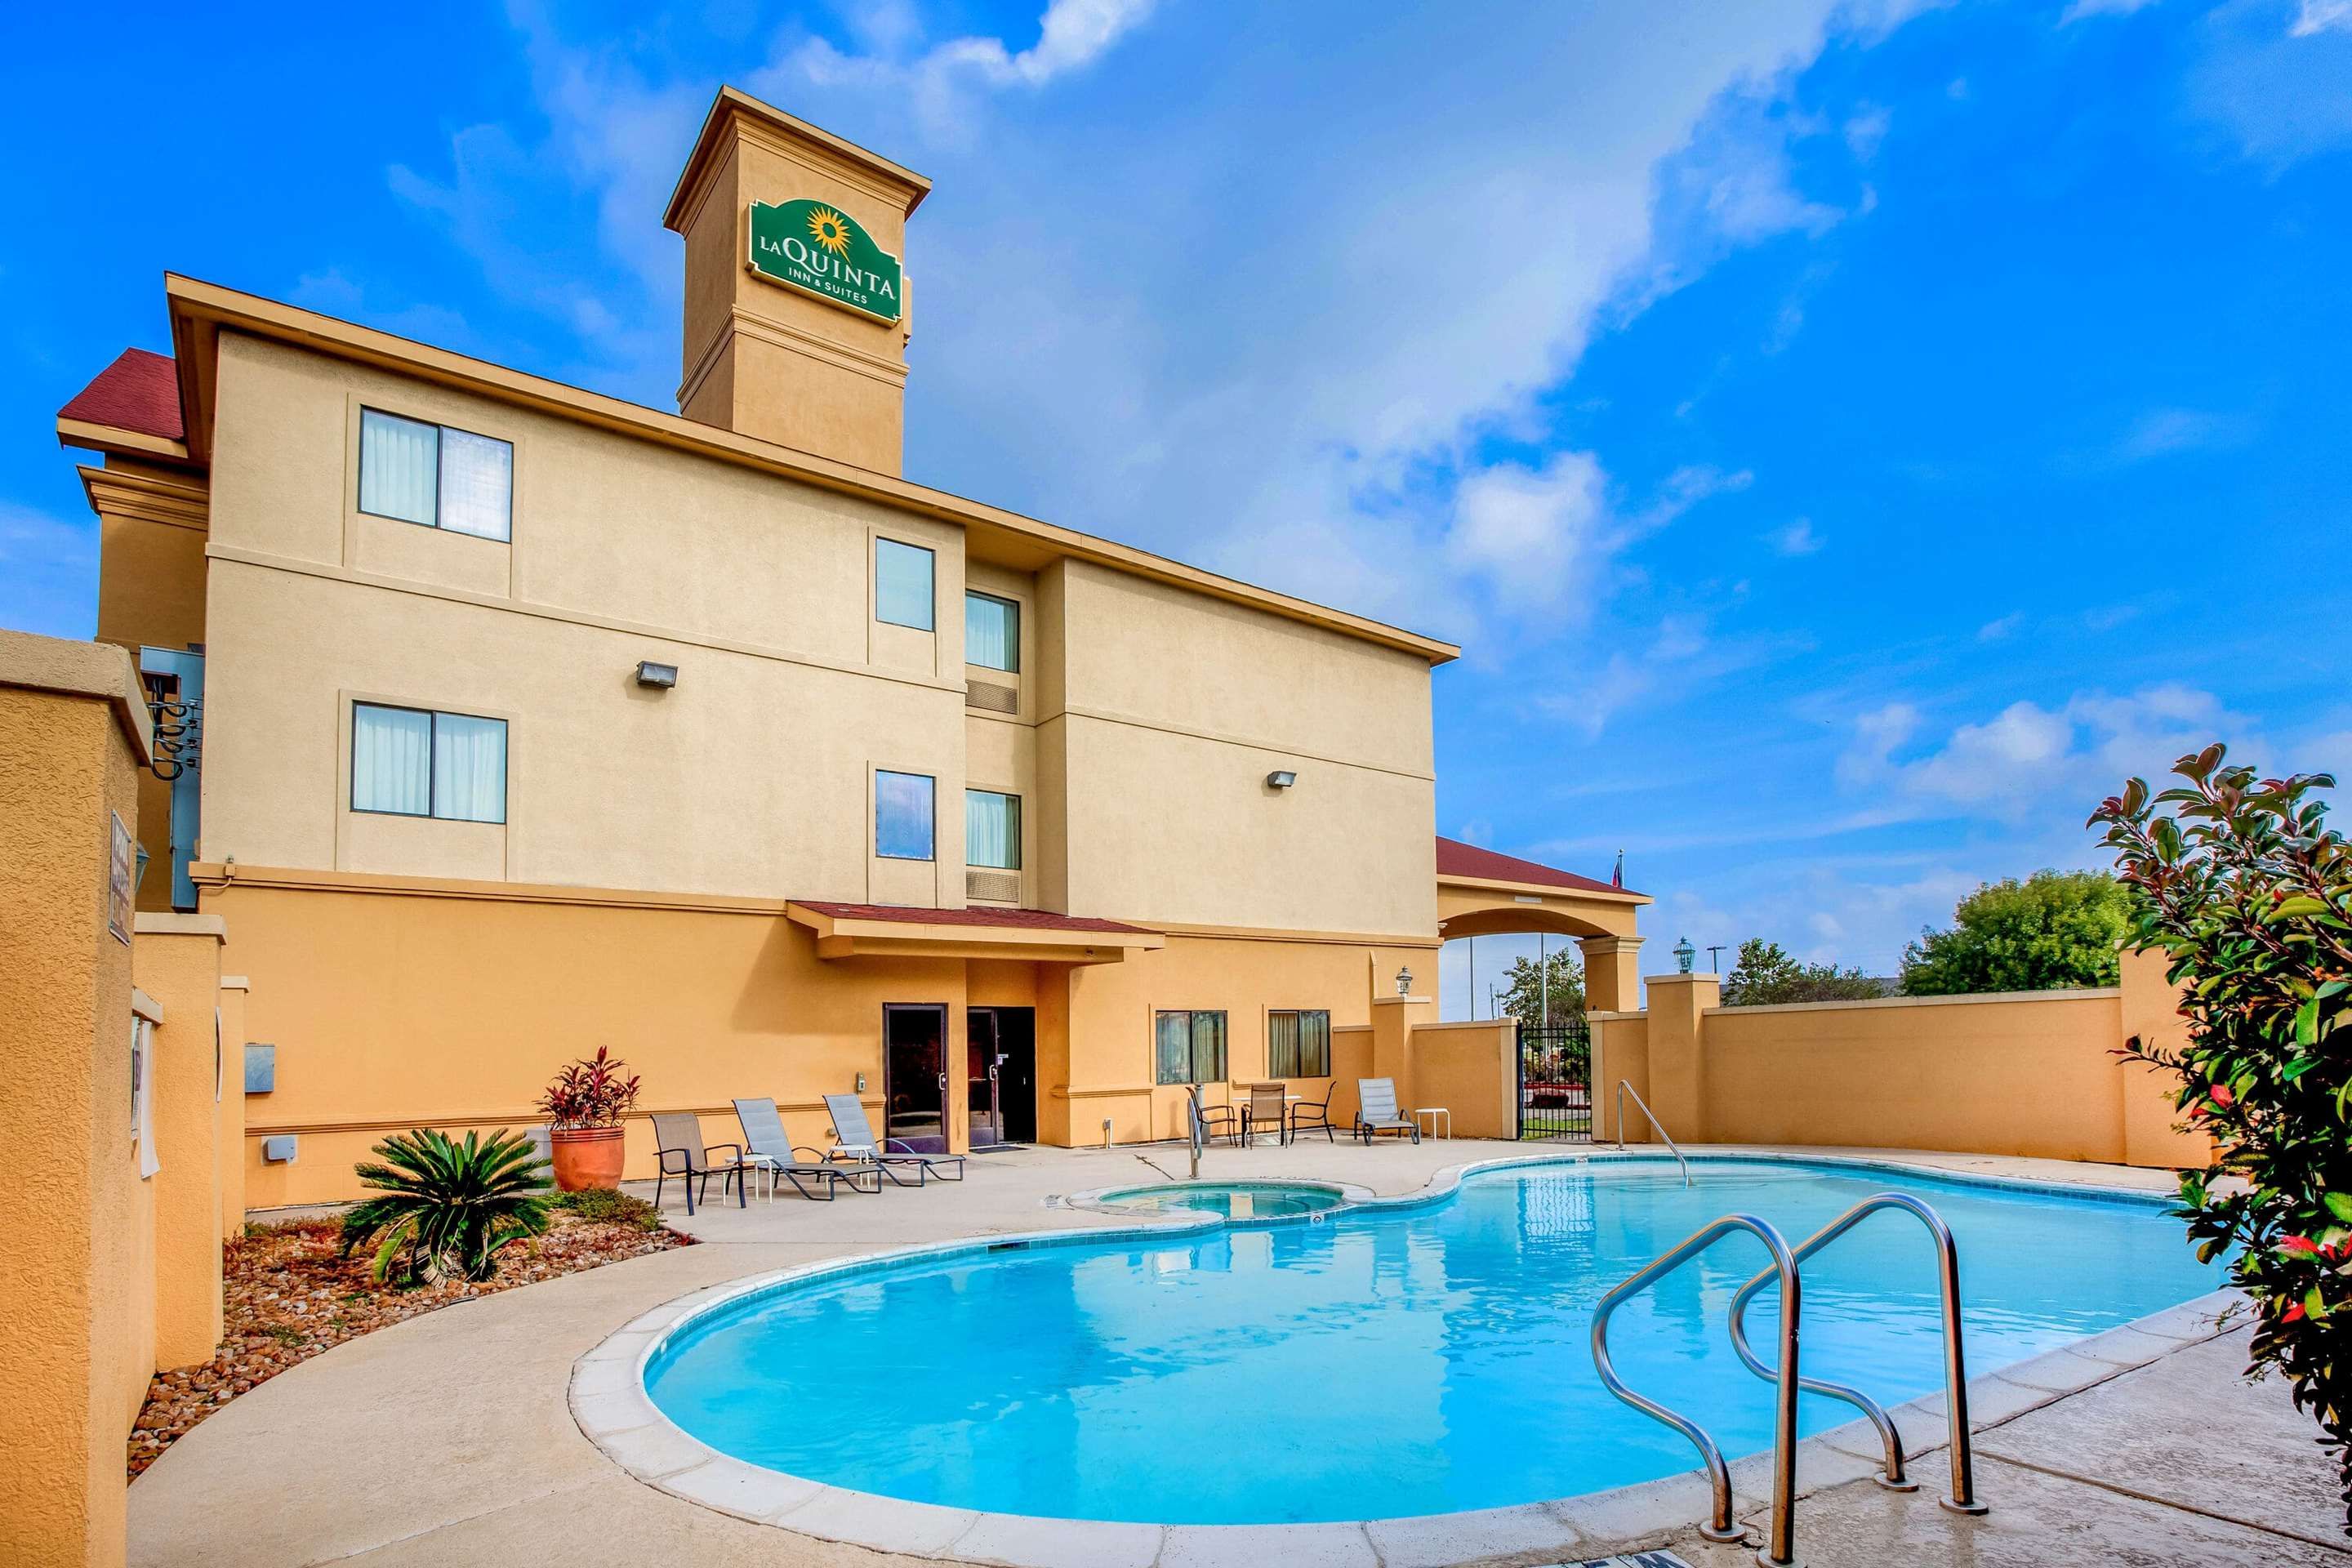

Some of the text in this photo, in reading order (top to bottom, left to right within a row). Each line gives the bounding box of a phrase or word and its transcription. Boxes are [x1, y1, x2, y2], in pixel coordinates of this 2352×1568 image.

[760, 236, 895, 300] LA QUINTA
[789, 267, 811, 283] INN
[825, 282, 867, 304] SUITES
